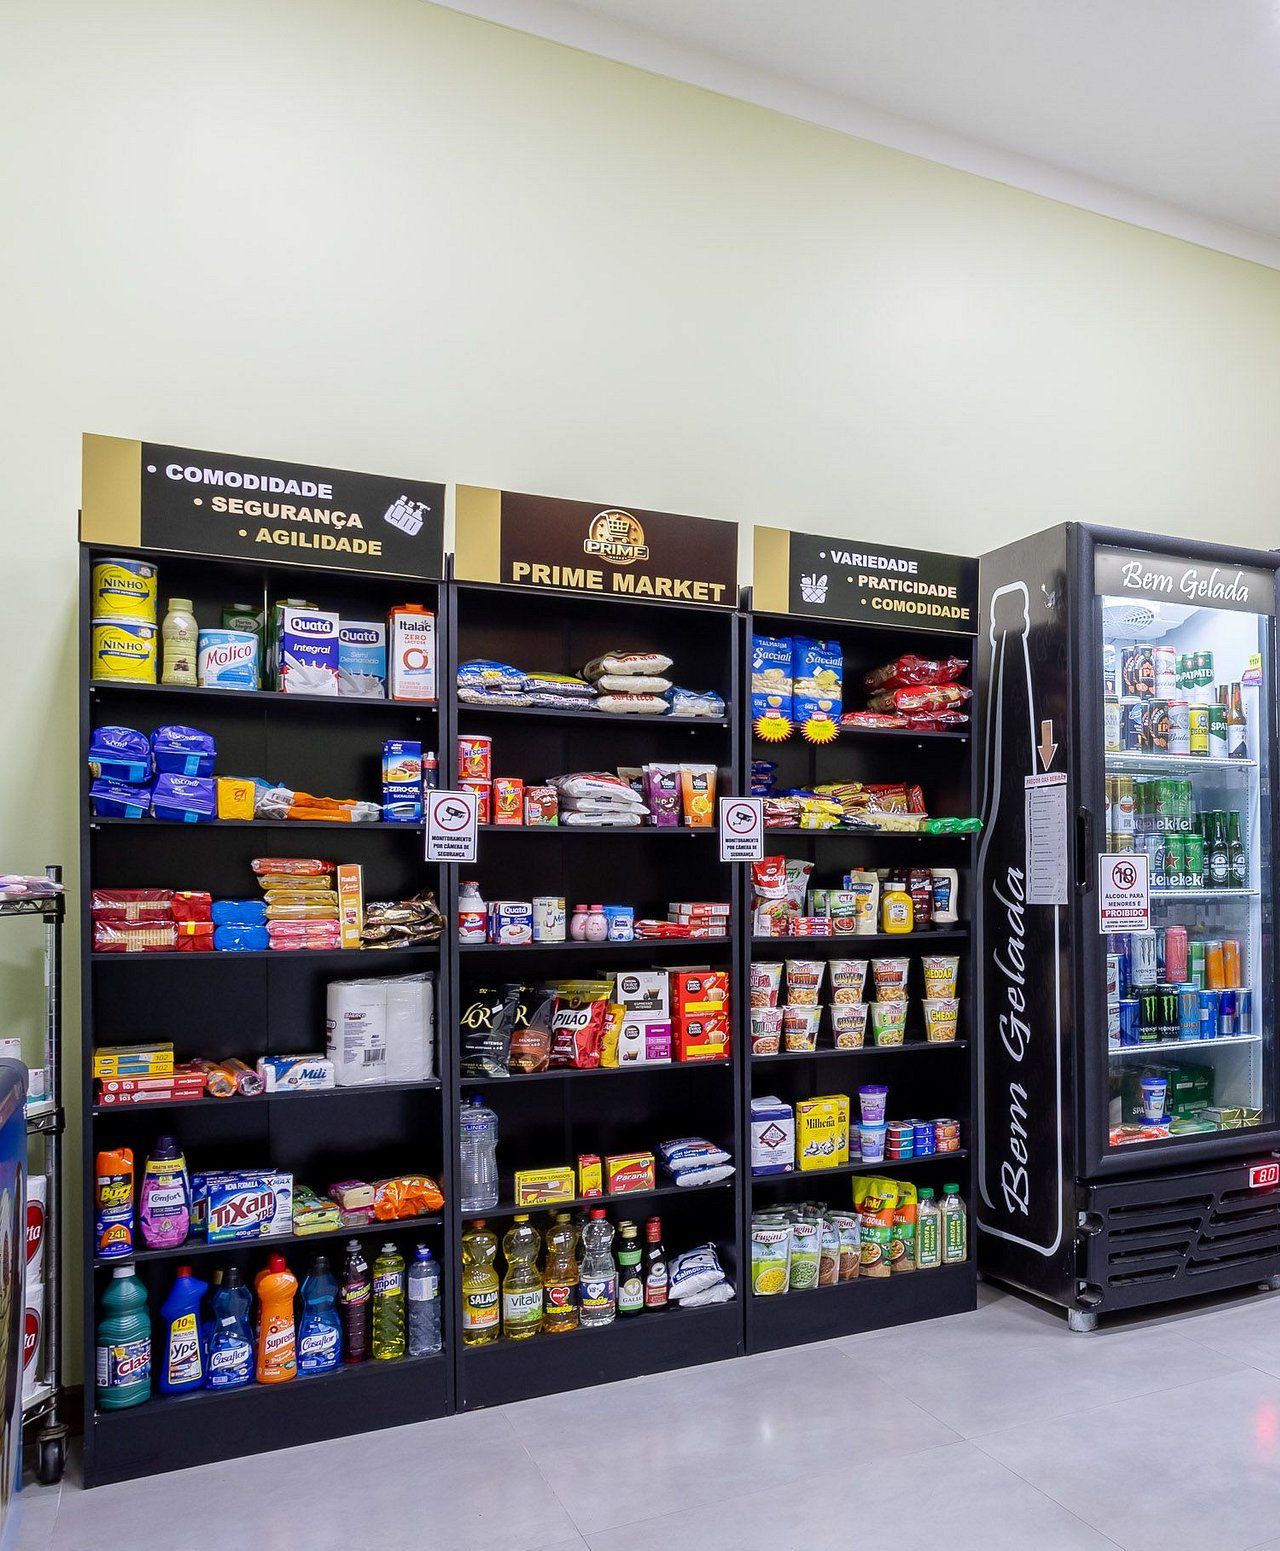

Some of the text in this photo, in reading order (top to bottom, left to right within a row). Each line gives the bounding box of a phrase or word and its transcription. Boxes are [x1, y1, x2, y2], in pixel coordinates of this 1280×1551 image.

[166, 464, 333, 500] COMODIDADE
[212, 497, 363, 529] SEGURANÇA
[255, 528, 382, 556] AGILIDADE
[587, 540, 647, 558] PRIME
[831, 550, 918, 574] VARIEDADE
[103, 578, 143, 589] NINHO
[512, 562, 726, 602] PRIME MARKET
[858, 575, 957, 598] PRATICIDADE
[1122, 561, 1249, 602] Bem Gelada
[872, 597, 970, 620] COMODIDADE
[292, 619, 331, 632] Quatá
[400, 620, 431, 631] Italac
[340, 630, 378, 642] Quatá
[103, 640, 143, 650] NINHO
[293, 643, 330, 654] Integral
[505, 906, 527, 914] Quatá
[1106, 909, 1144, 917] PROIBIDO
[993, 867, 1031, 1216] Bem Gelada
[299, 1068, 327, 1081] Mili
[151, 1193, 181, 1203] Comfort
[107, 1229, 127, 1240] 24h
[754, 1230, 788, 1242] Fugini
